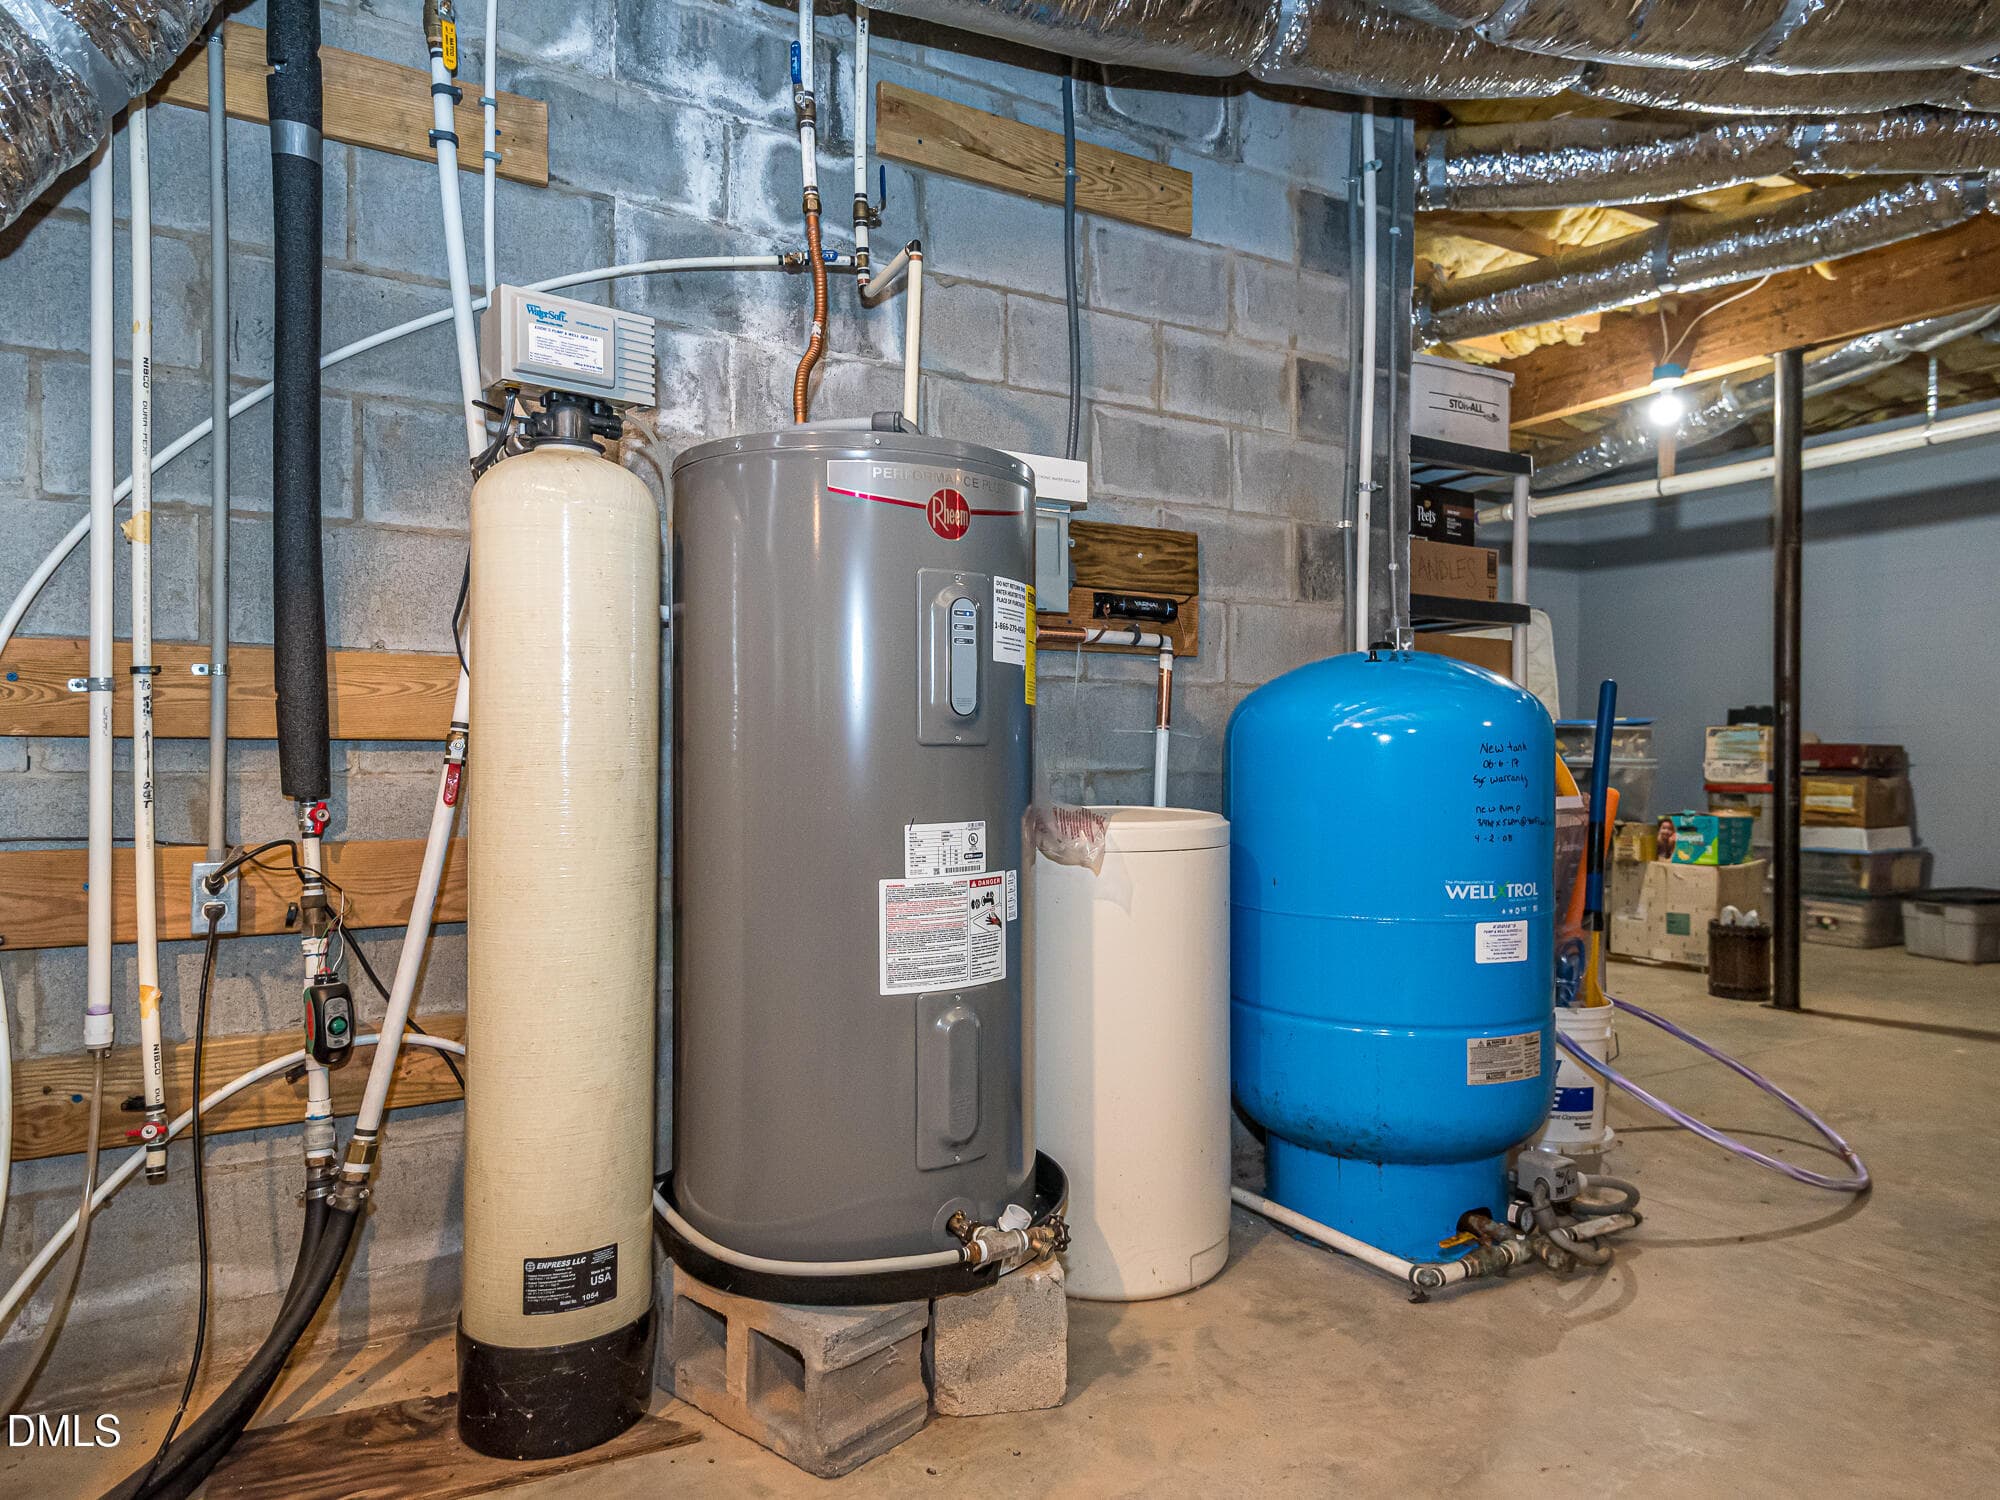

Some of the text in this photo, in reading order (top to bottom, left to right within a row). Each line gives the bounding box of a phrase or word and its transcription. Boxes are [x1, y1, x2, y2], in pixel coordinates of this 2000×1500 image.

[932, 489, 969, 532] Rheem
[1480, 743, 1504, 754] New
[1490, 774, 1528, 788] warranty
[977, 877, 1001, 887] DANGER
[153, 1043, 161, 1075] NIBCO
[536, 1256, 587, 1270] ENPRESS LLC
[590, 1272, 612, 1286] USA
